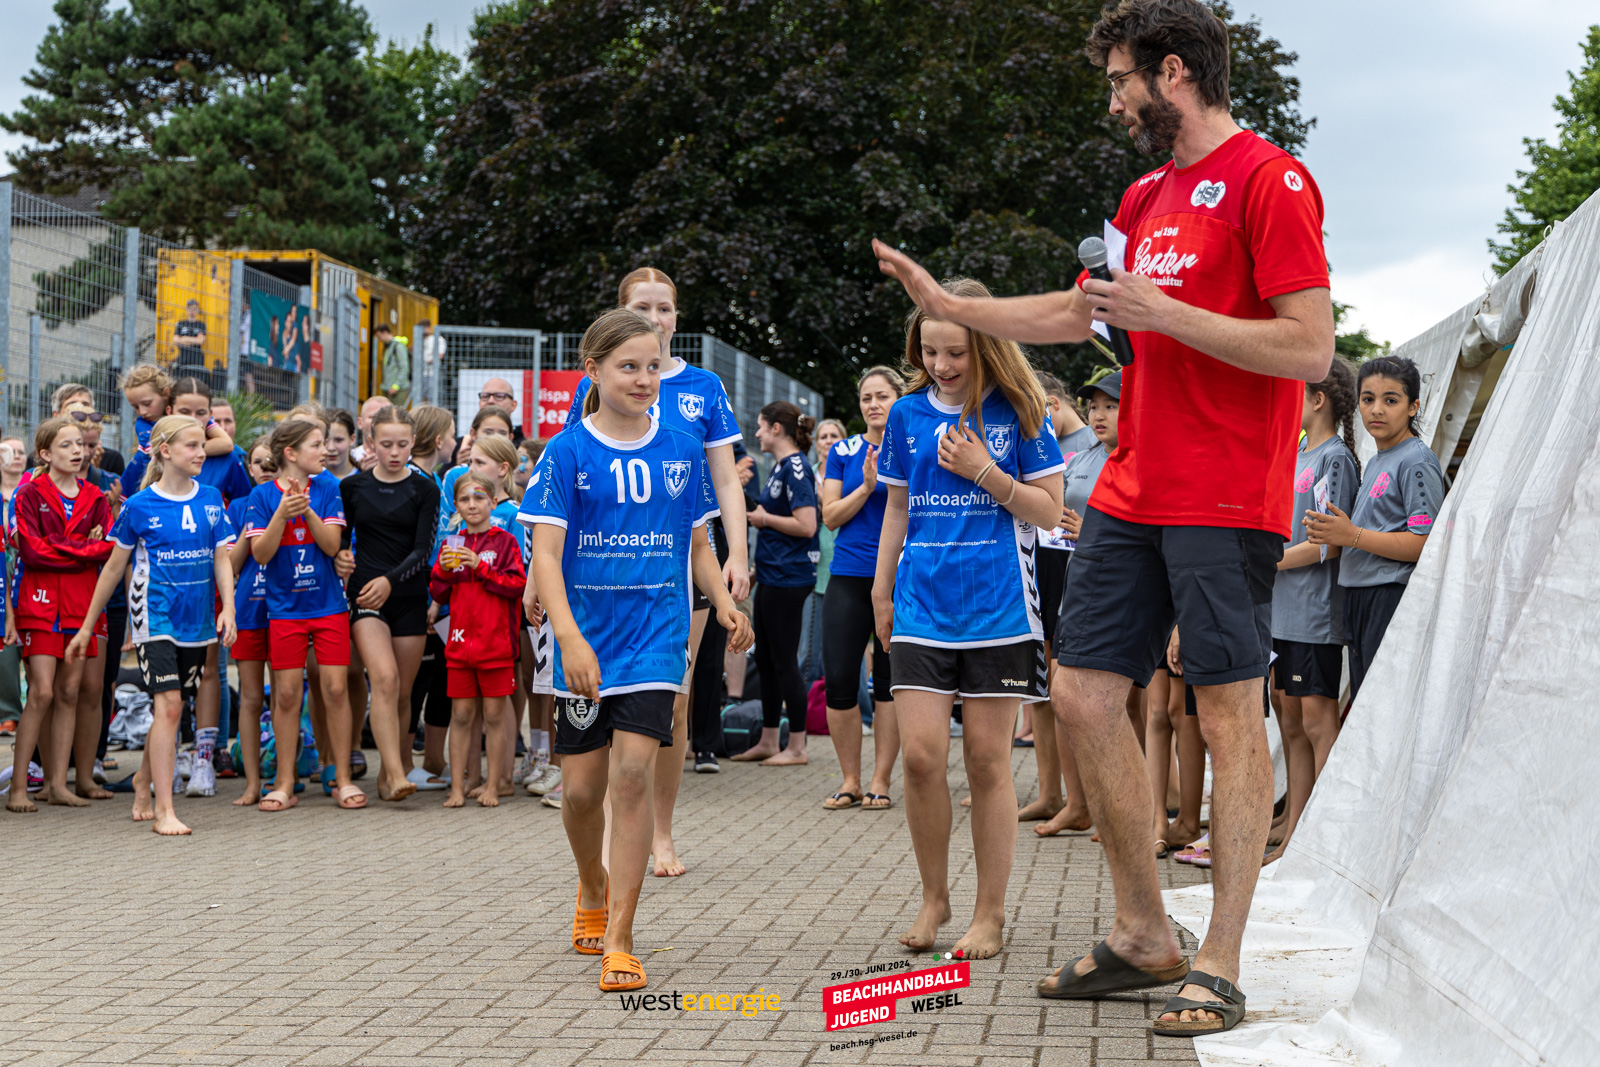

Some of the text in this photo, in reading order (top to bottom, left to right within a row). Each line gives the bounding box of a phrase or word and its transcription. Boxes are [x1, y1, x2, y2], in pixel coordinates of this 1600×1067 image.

[609, 458, 651, 504] 10
[181, 505, 197, 533] 4
[298, 549, 306, 561] 7
[32, 589, 50, 604] JL
[25, 632, 32, 647] 5
